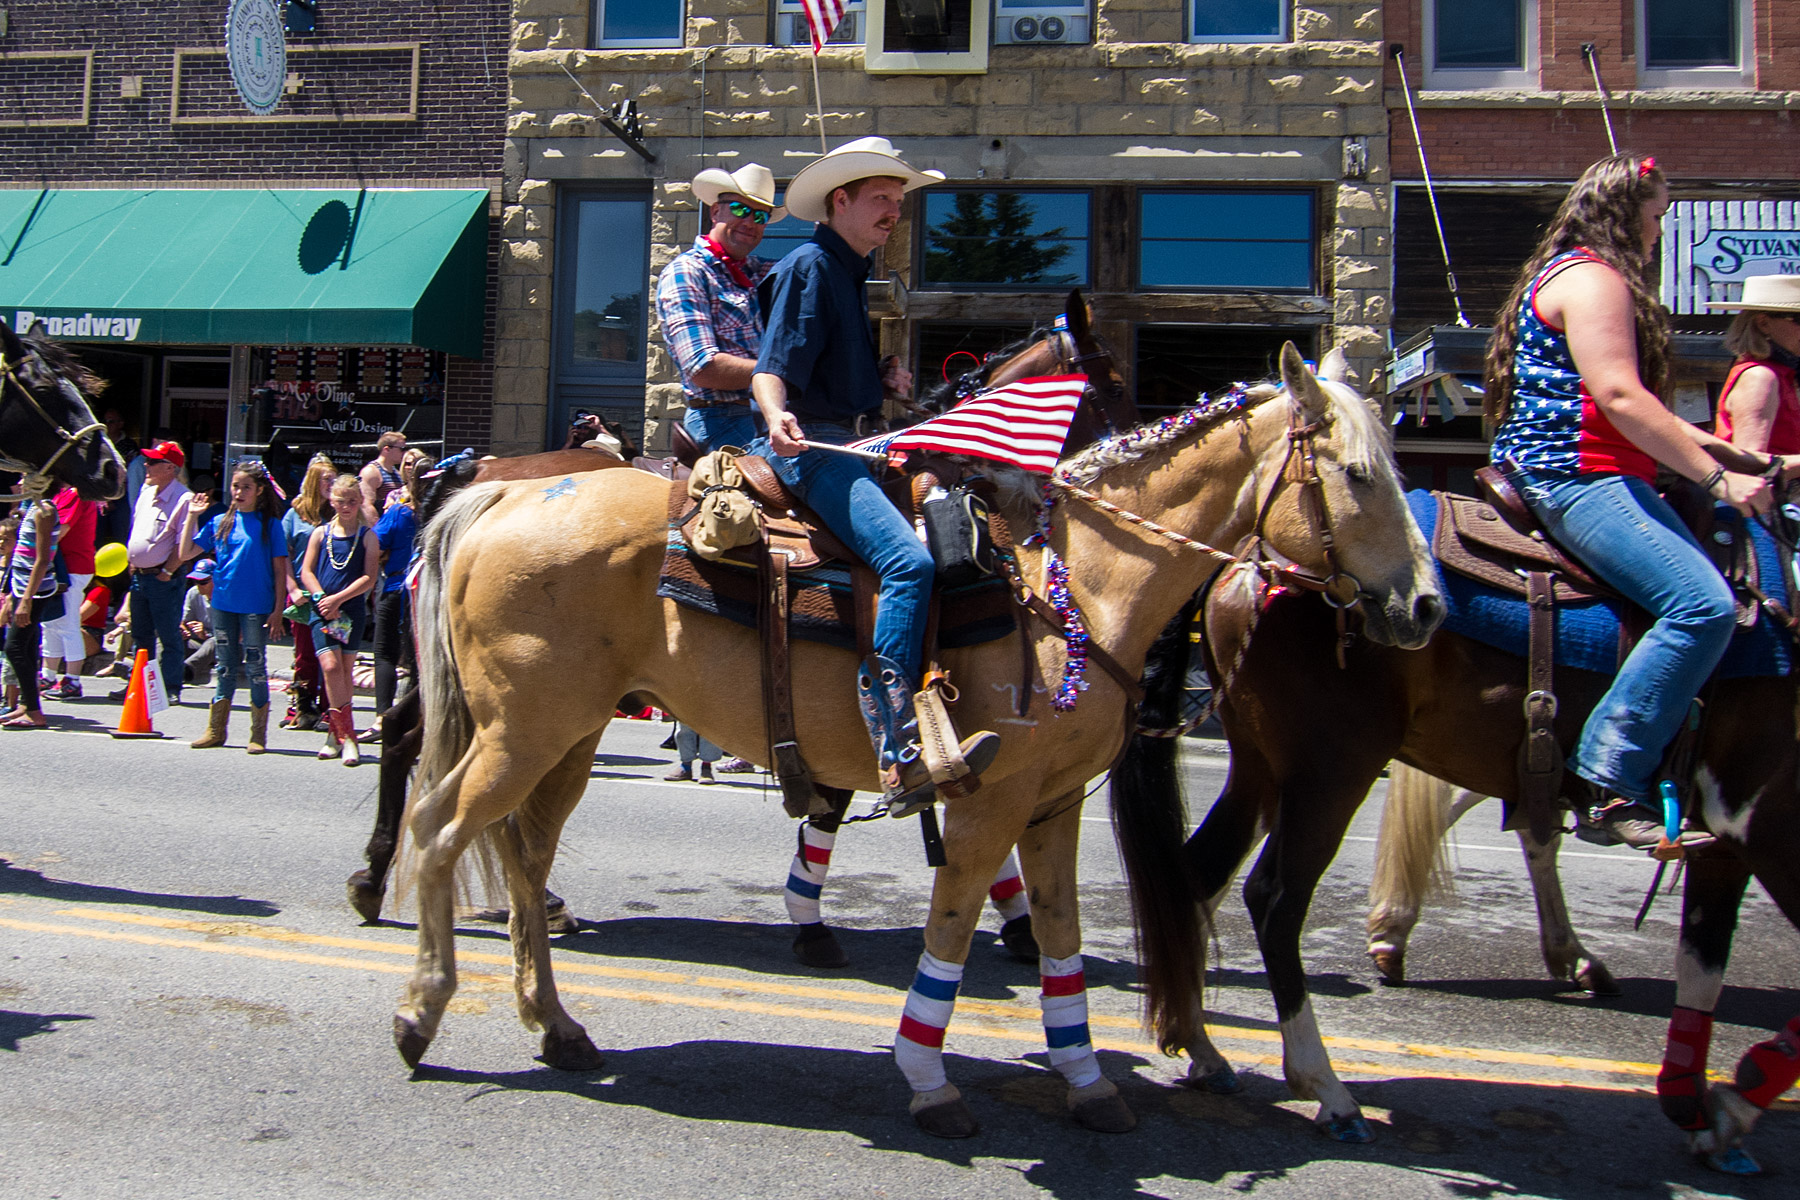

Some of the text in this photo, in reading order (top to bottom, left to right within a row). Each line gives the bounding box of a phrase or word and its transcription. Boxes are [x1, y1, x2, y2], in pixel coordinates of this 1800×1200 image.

[1712, 236, 1800, 274] SYLVAN
[280, 381, 355, 409] My Time
[320, 418, 393, 436] Nail Design
